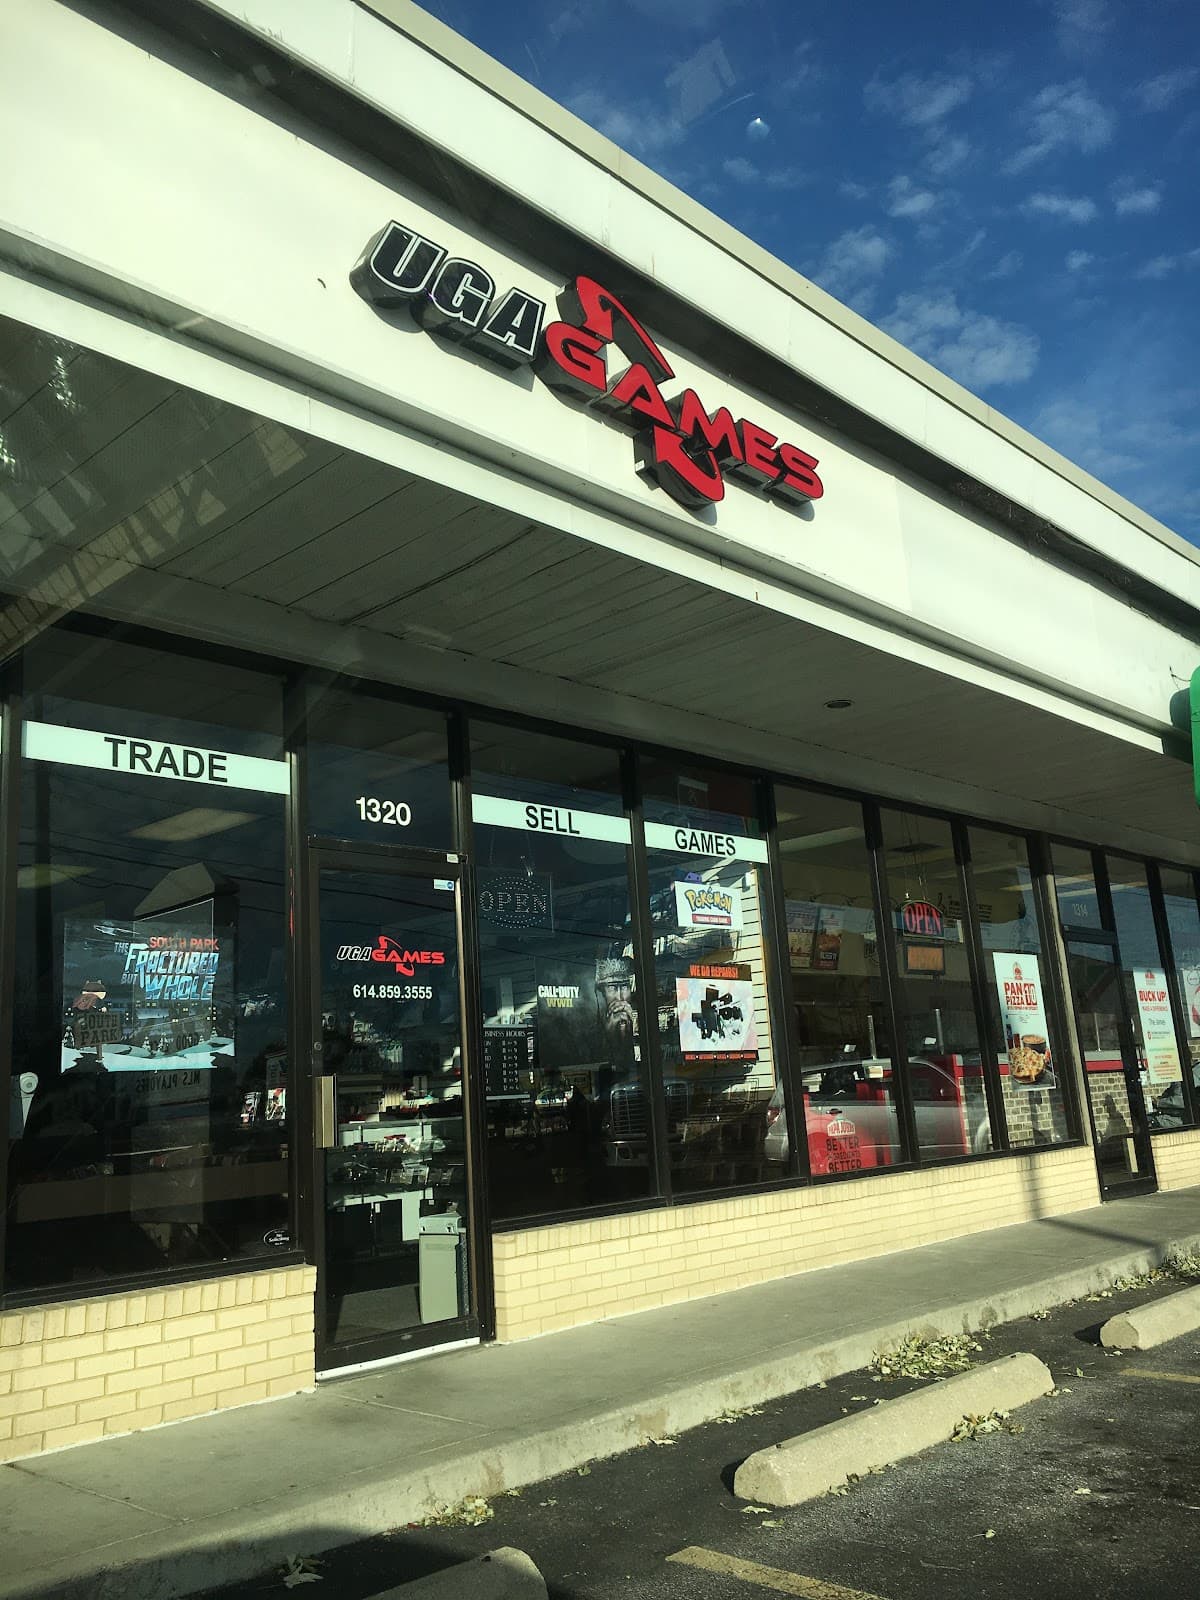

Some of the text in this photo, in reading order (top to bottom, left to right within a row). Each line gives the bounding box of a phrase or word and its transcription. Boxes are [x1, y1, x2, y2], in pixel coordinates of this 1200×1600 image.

[368, 219, 824, 500] UGA GAMES
[104, 736, 228, 783] TRADE
[355, 796, 412, 827] 1320
[525, 805, 580, 835] SELL
[674, 829, 736, 856] GAMES
[480, 891, 547, 913] OPEN
[904, 901, 942, 935] OPEN
[190, 937, 219, 951] PARK
[336, 945, 446, 965] UGA GAMES
[125, 943, 219, 977] FRACTURED
[145, 974, 215, 1000] WHOLE
[352, 984, 433, 1000] 614.859.3555
[1004, 982, 1023, 996] PAN
[546, 998, 574, 1008] WWII
[1006, 995, 1025, 1006] PIZZA
[826, 1136, 860, 1151] BETTER
